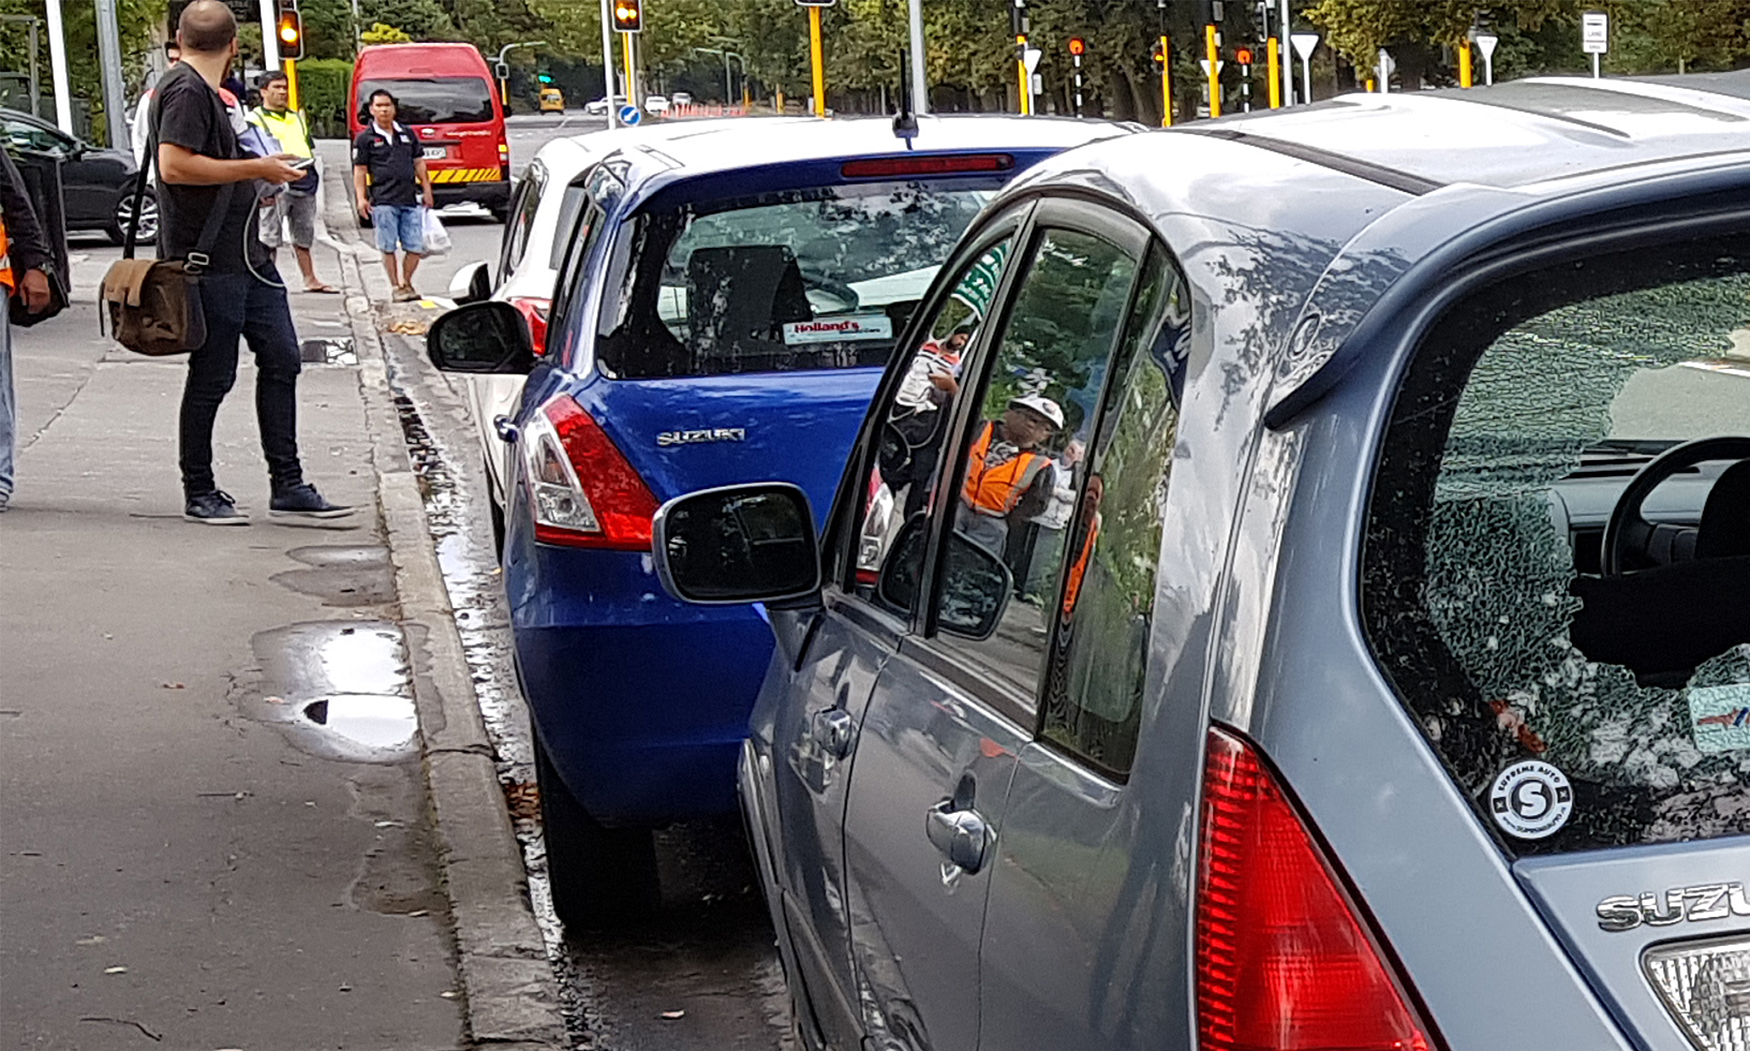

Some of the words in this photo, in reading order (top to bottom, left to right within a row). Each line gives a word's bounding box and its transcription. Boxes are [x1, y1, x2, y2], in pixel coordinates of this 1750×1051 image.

[794, 321, 860, 333] Holland's
[656, 427, 745, 446] SUZUKI
[1498, 766, 1534, 791] SUPREME
[1538, 767, 1560, 783] AUTO
[1519, 781, 1547, 817] S
